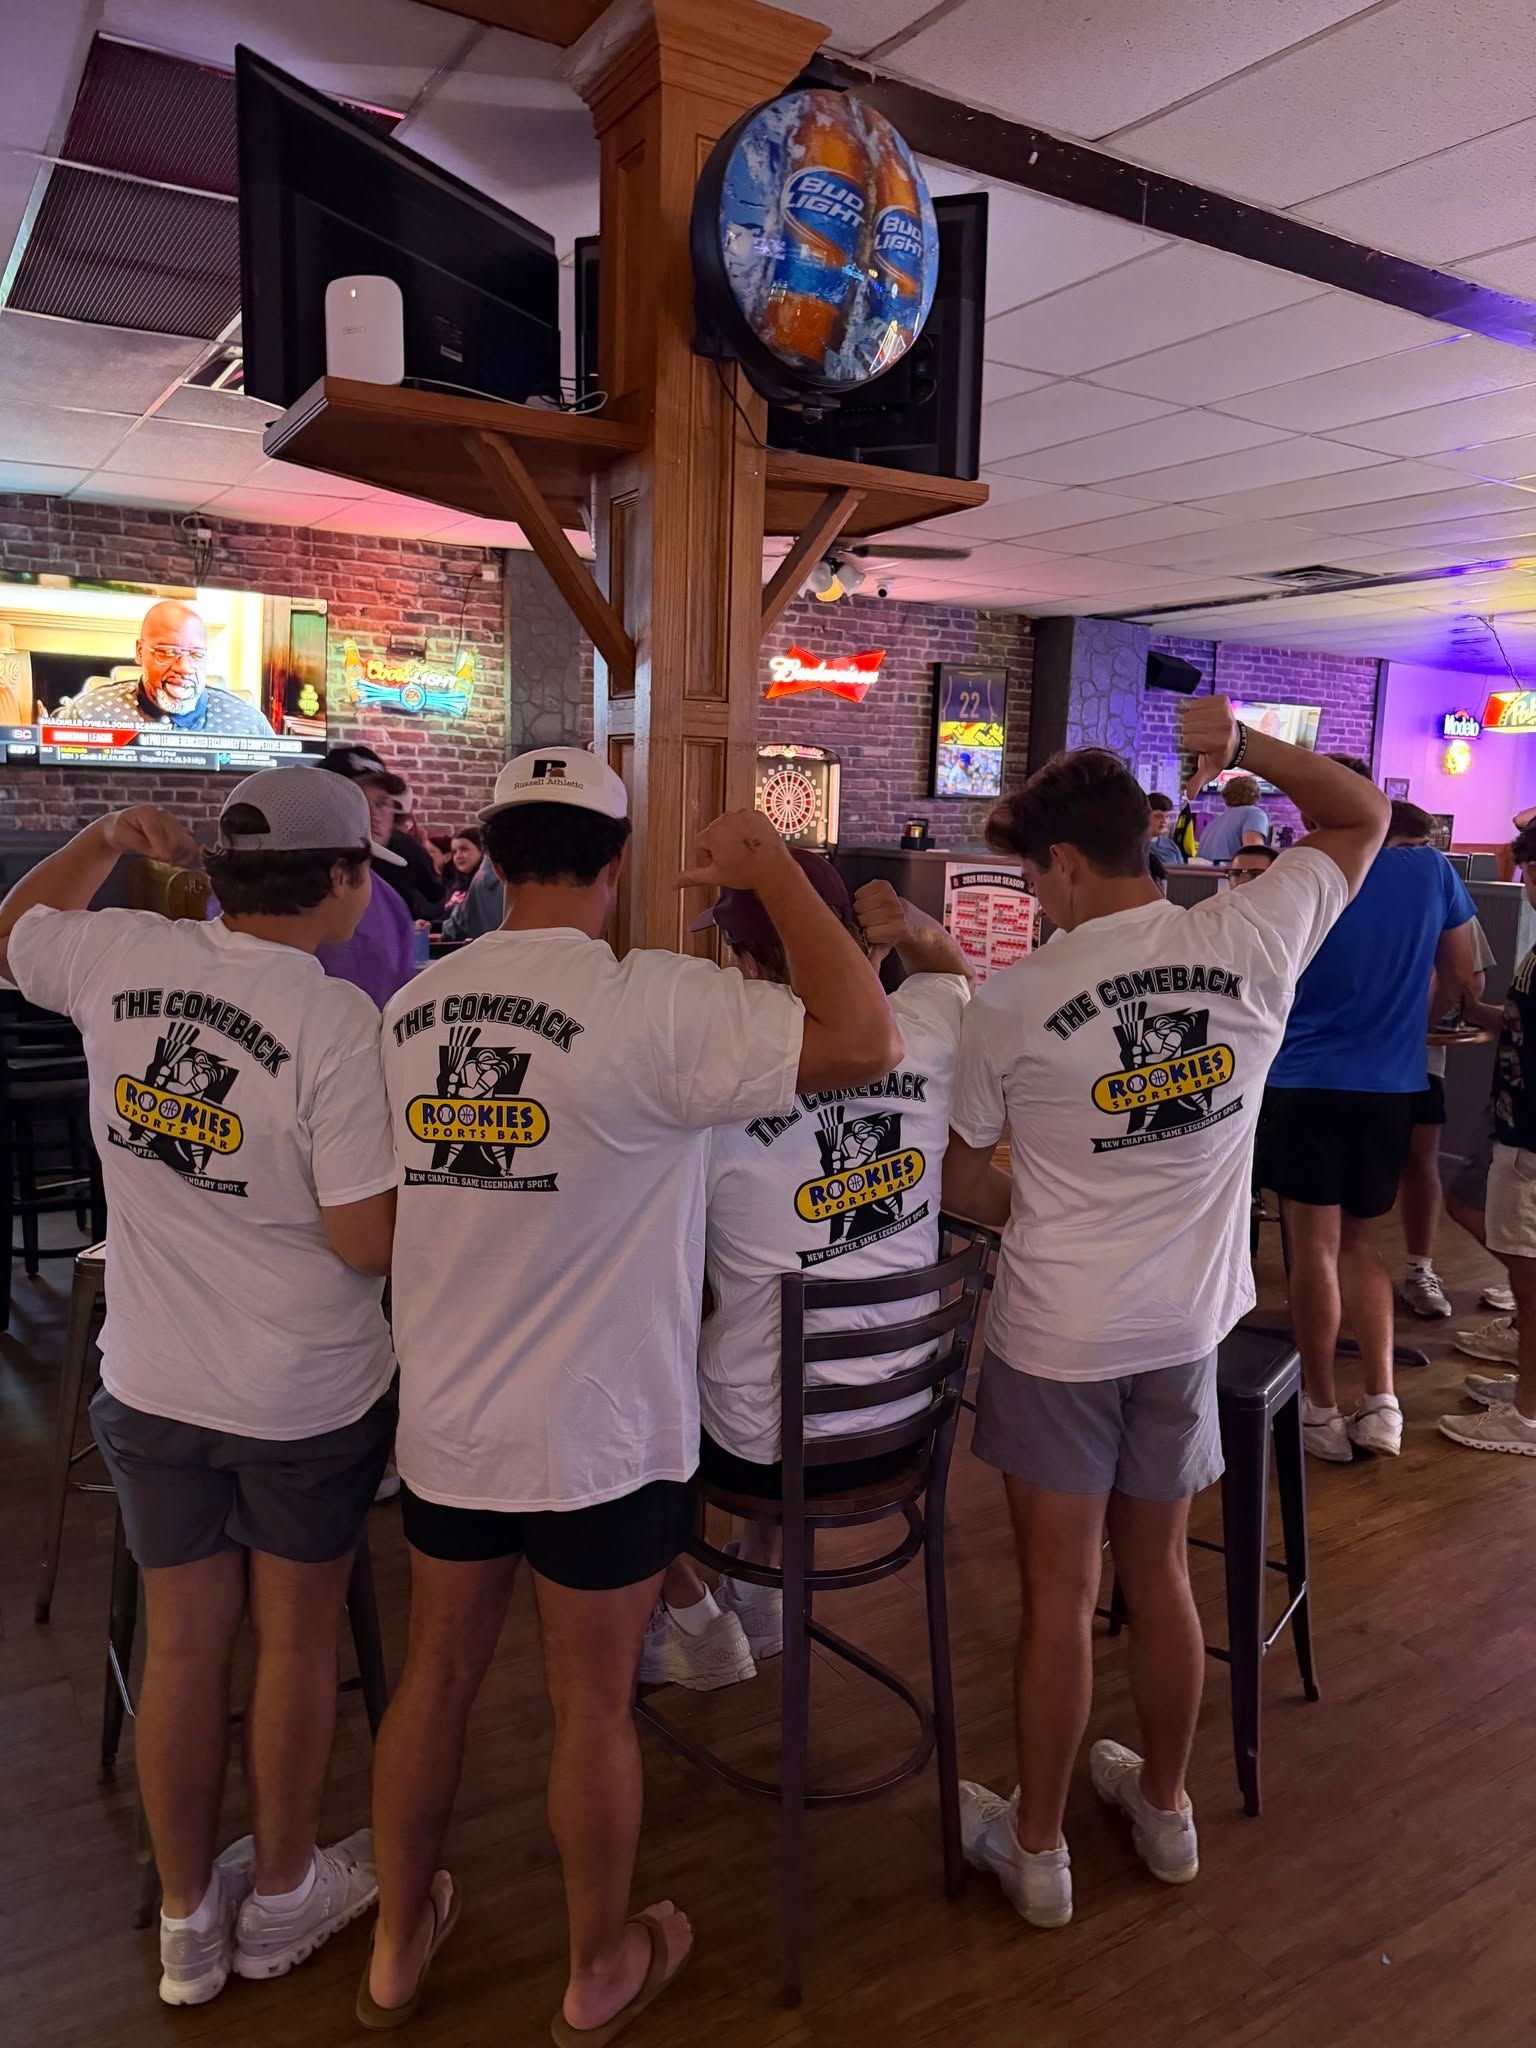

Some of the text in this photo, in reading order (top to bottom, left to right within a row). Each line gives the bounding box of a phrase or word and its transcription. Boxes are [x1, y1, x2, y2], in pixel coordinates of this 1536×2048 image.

[786, 192, 865, 228] LIGHT
[797, 177, 865, 210] BUD
[875, 234, 924, 259] LIGHT
[882, 215, 922, 242] BUD
[960, 691, 980, 718] 22
[1444, 714, 1480, 737] Modelo
[513, 777, 583, 789] Russell Athletic
[977, 874, 1002, 885] REGULAR
[1002, 876, 1026, 889] SEASON
[1044, 964, 1243, 1041] THE COMEBACK
[112, 988, 291, 1078] THE COMEBACK
[392, 993, 585, 1053] THE COMEBACK
[1108, 1050, 1224, 1100] ROOKIES
[1112, 1071, 1227, 1110] SPORTS BAR
[123, 1104, 229, 1150] SPORTS BAR
[126, 1082, 231, 1138] ROOKIES
[422, 1102, 534, 1129] ROOKIES
[423, 1127, 533, 1142] SPORTS BAR
[1101, 1138, 1120, 1149] NEW
[1121, 1134, 1160, 1147] CHAPTER.
[1161, 1127, 1183, 1139] SAME
[1183, 1112, 1223, 1134] LEGENDARY
[217, 1182, 241, 1193] SPOT.
[409, 1172, 551, 1190] NEW CHAPTER. SAME LEGENDARY SPOT.
[809, 1155, 915, 1207] ROOKIES
[813, 1175, 915, 1217] SPORTS BAR
[806, 1251, 825, 1263] NEW
[825, 1241, 860, 1259] CHAPTER.
[859, 1232, 878, 1247] SAME
[877, 1218, 912, 1241] LEGENDARY
